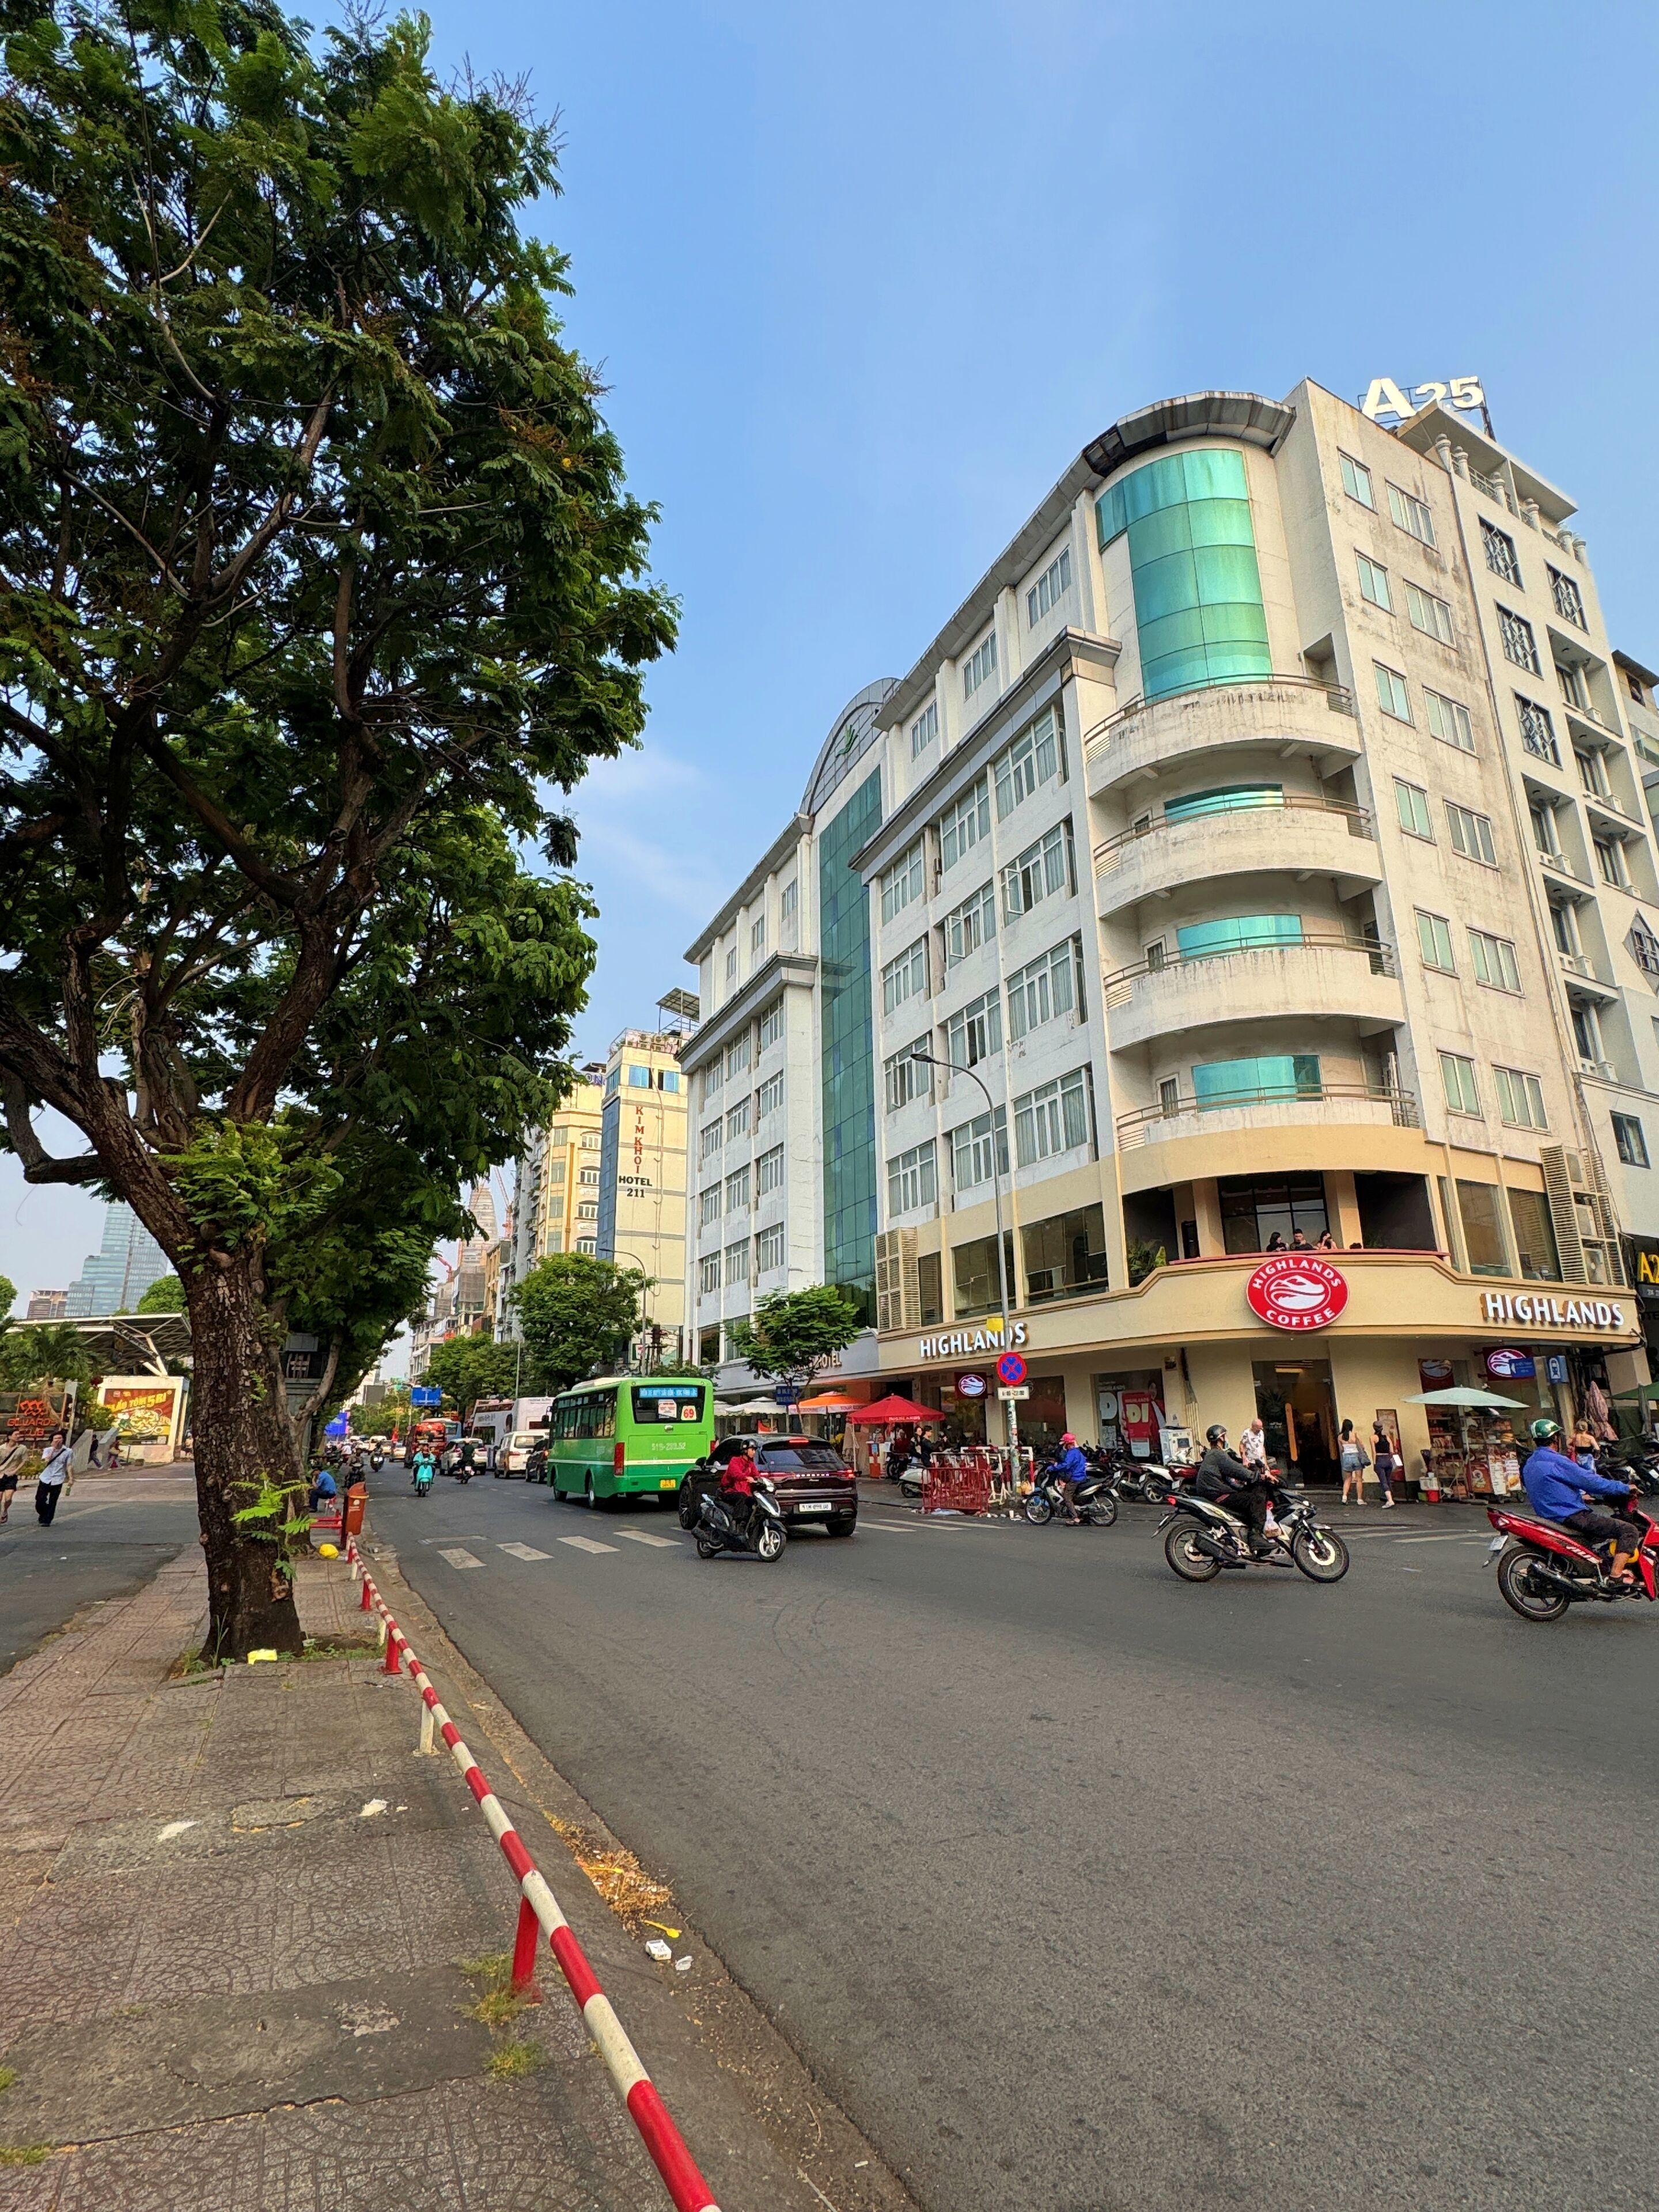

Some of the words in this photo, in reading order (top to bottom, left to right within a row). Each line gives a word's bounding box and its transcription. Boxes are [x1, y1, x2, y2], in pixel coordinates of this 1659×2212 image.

[1362, 376, 1484, 420] A25
[635, 1105, 645, 1135] KIM
[619, 1175, 653, 1187] HOTEL
[627, 1188, 645, 1198] 211
[1252, 1259, 1342, 1290] HIGHLANDS
[1266, 1307, 1335, 1326] COFFEE
[1481, 1293, 1624, 1326] HIGHLANDS
[683, 1408, 694, 1418] 69
